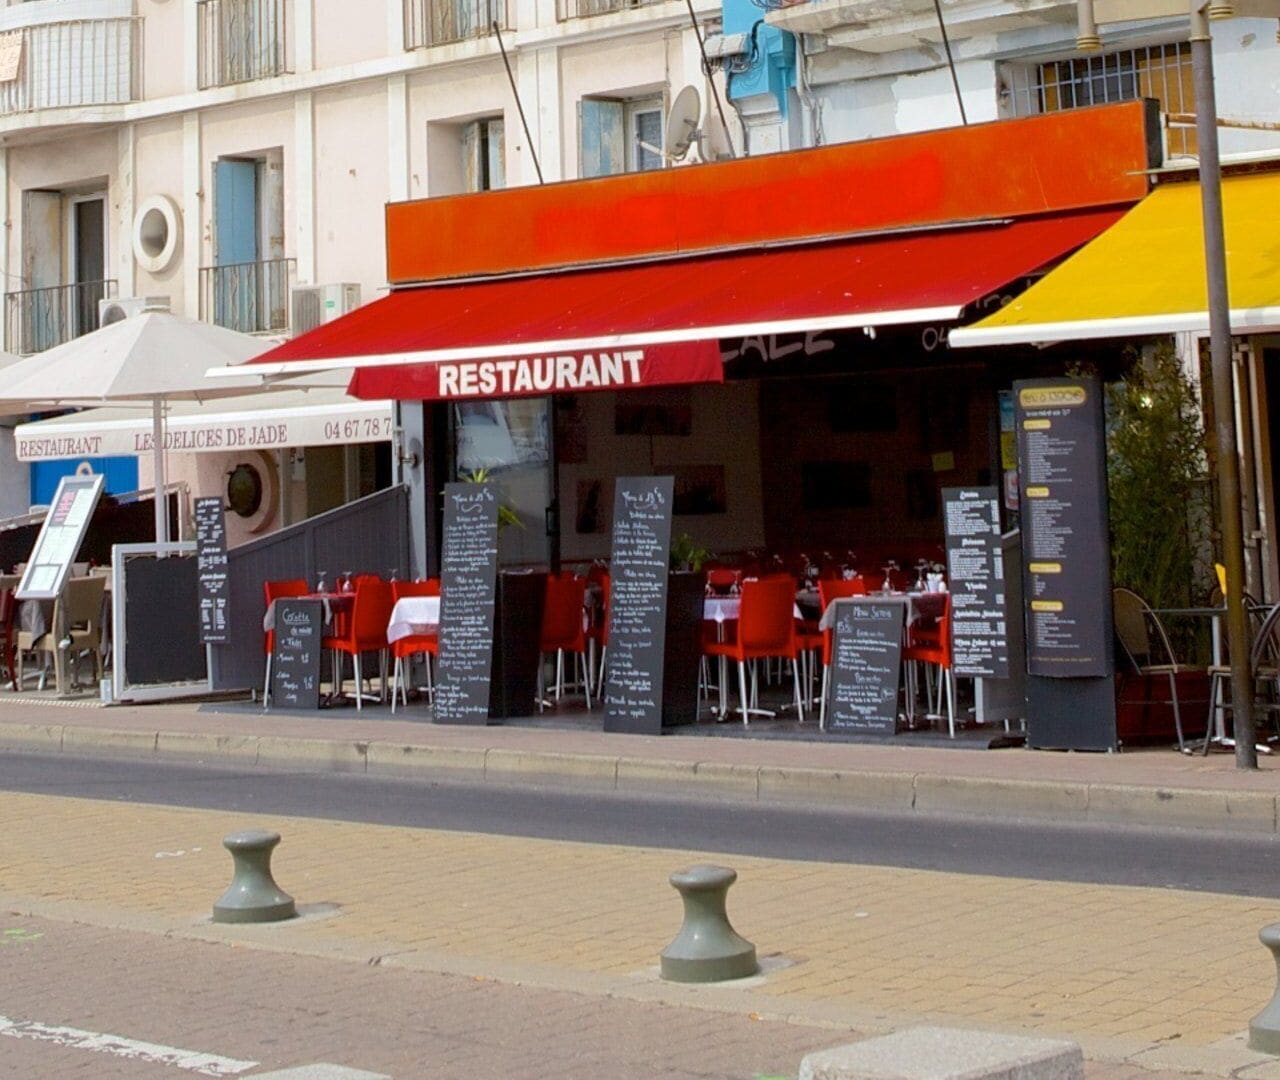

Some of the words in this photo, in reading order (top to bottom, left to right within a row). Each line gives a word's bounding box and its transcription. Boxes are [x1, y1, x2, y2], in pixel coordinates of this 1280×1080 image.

[439, 350, 644, 396] RESTAURANT
[20, 435, 102, 457] RESTAURANT
[163, 428, 223, 451] DELICES
[227, 427, 246, 446] DE
[249, 423, 288, 444] JADE
[324, 422, 340, 439] 04
[344, 420, 360, 437] 67
[363, 418, 380, 436] 78
